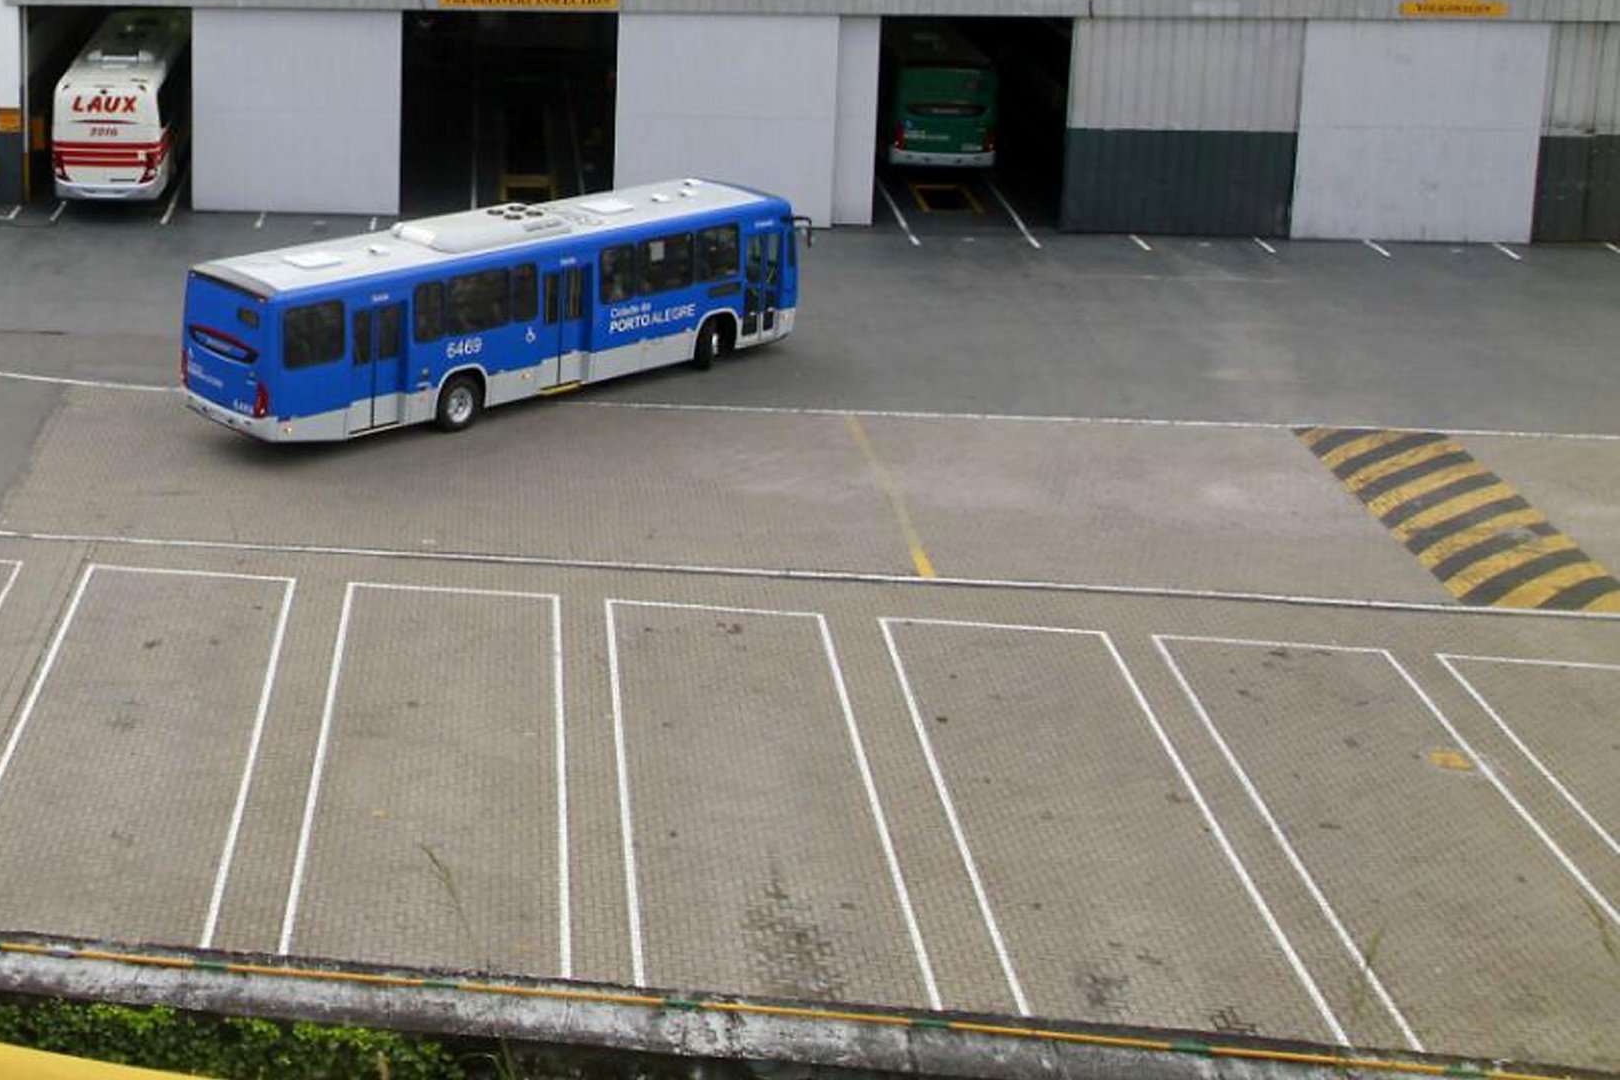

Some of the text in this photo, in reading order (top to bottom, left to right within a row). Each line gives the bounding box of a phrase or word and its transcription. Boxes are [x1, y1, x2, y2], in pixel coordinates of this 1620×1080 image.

[72, 96, 137, 112] LAUX
[609, 303, 696, 334] PORTO ALEGRE
[446, 336, 482, 359] 6469
